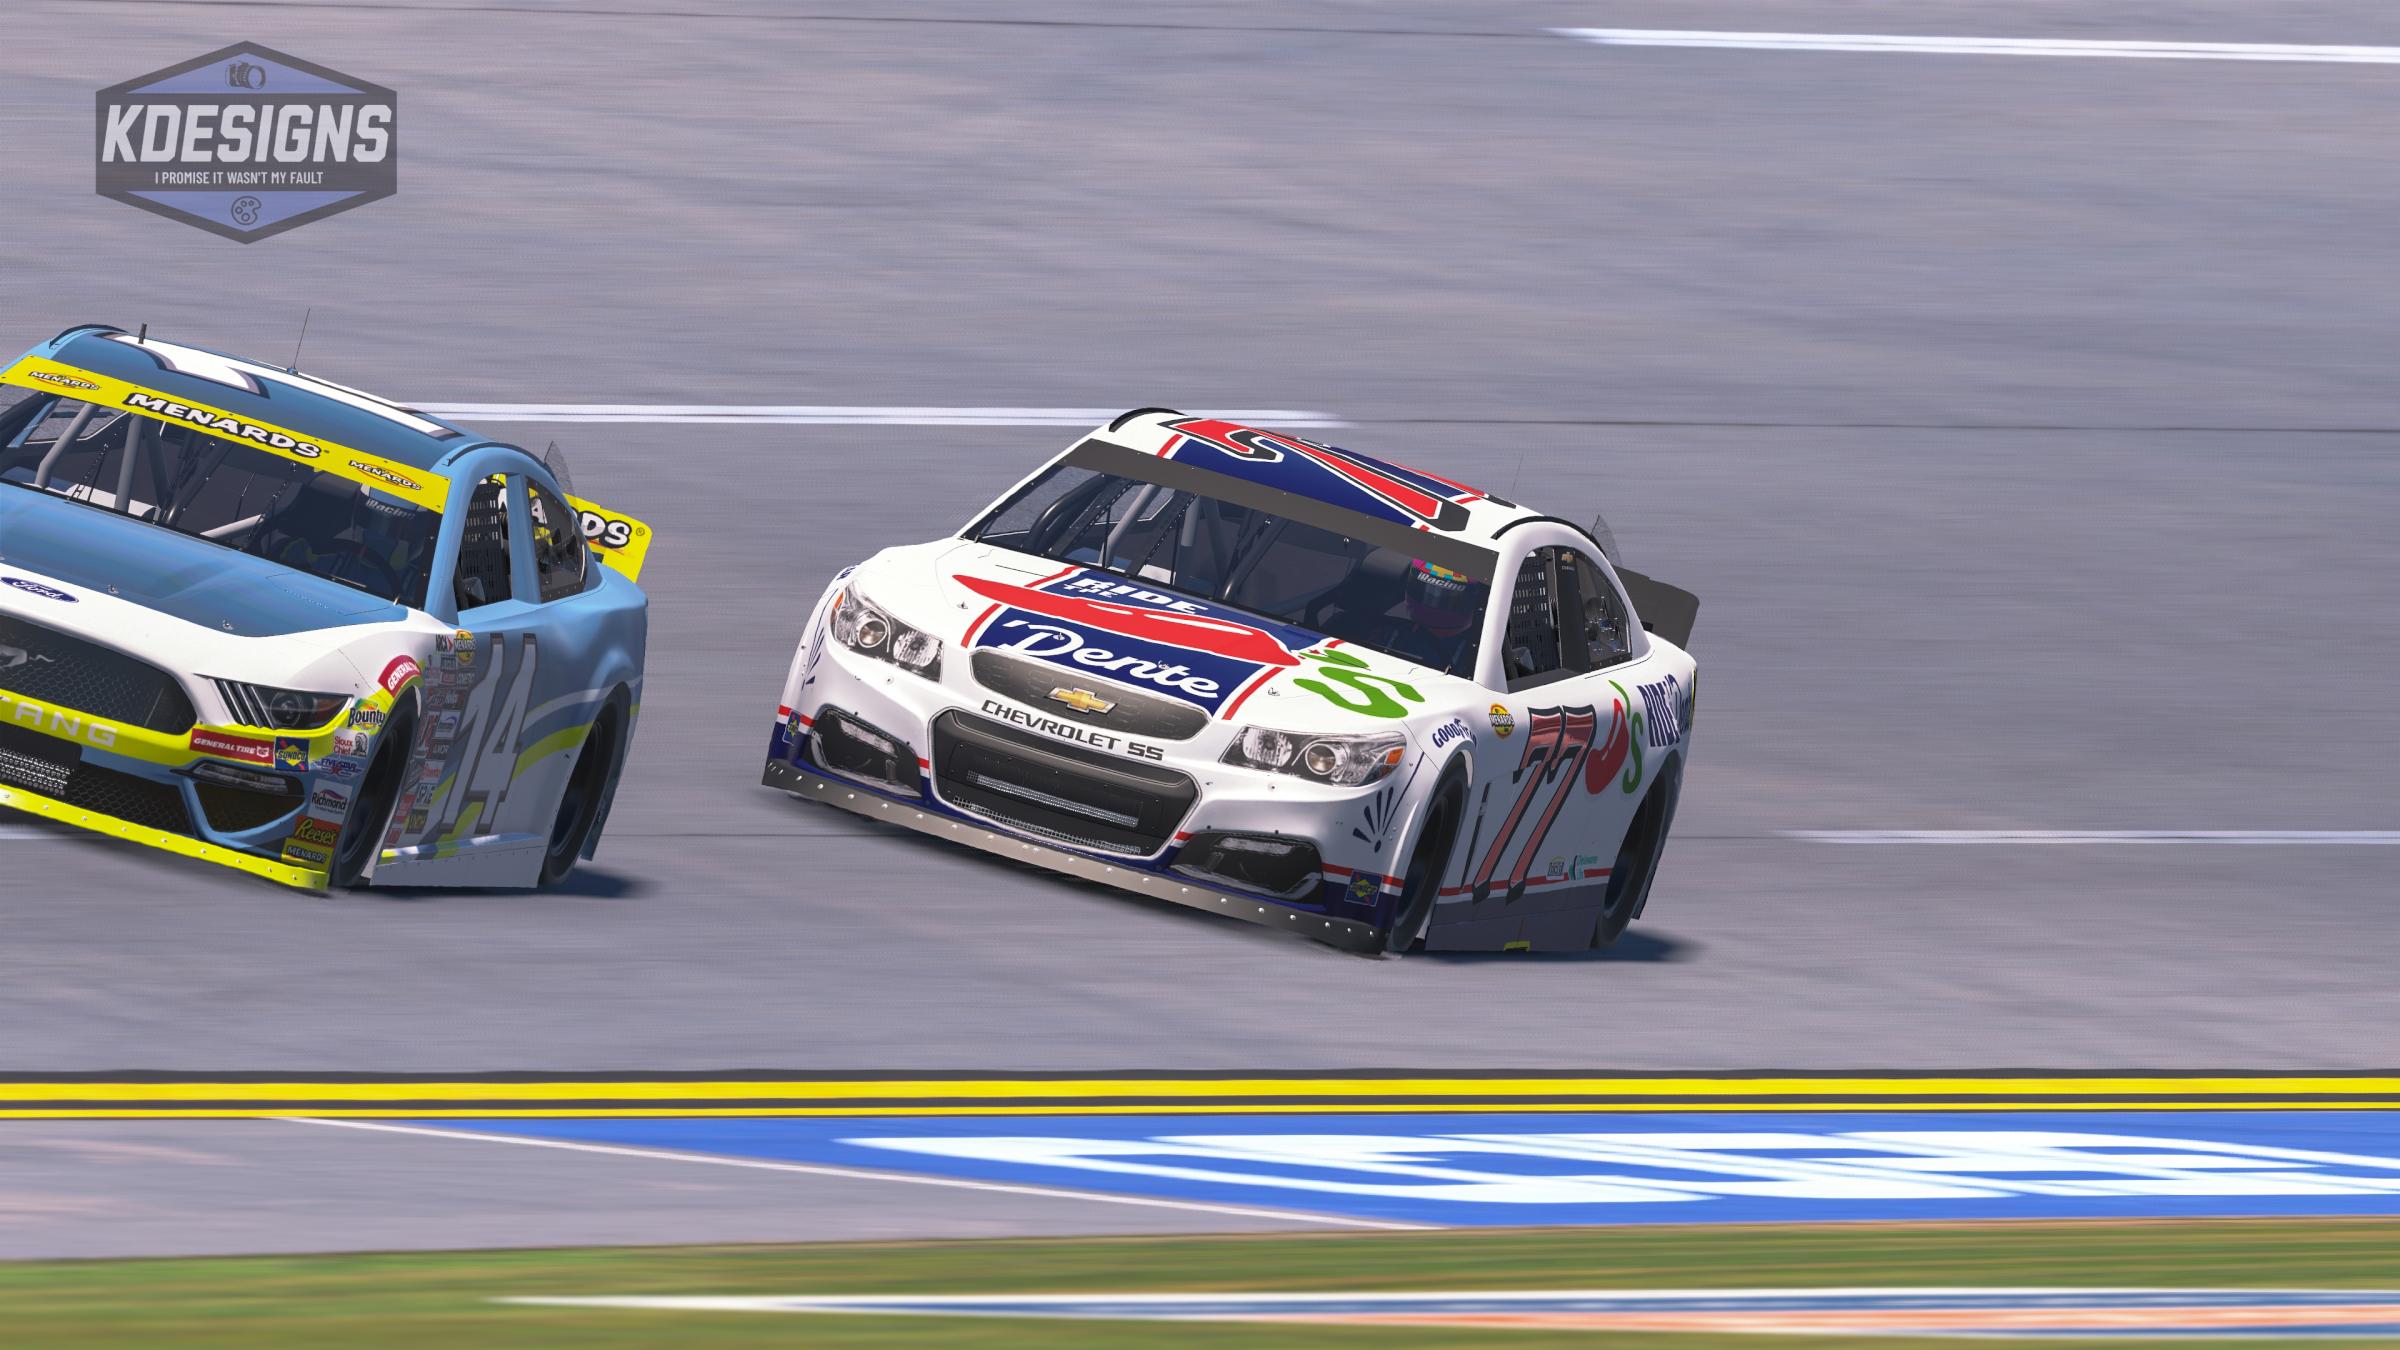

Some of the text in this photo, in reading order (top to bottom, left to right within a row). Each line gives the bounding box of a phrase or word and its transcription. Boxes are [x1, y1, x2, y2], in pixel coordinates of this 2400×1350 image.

[28, 370, 100, 391] MENARDS
[123, 392, 322, 458] MENARDS
[347, 459, 422, 491] MENARDS
[13, 579, 64, 600] Ford
[1072, 578, 1209, 615] RIDE
[347, 706, 386, 729] Bounty
[334, 735, 353, 747] Sioux
[439, 632, 538, 834] 14
[981, 699, 1165, 761] CHEVROLET SS
[193, 738, 256, 755] GENERAL TIRE
[277, 750, 307, 761] SUNOCO
[311, 792, 348, 811] Richmond
[1472, 704, 1598, 906] 77
[287, 846, 327, 863] MENARDS
